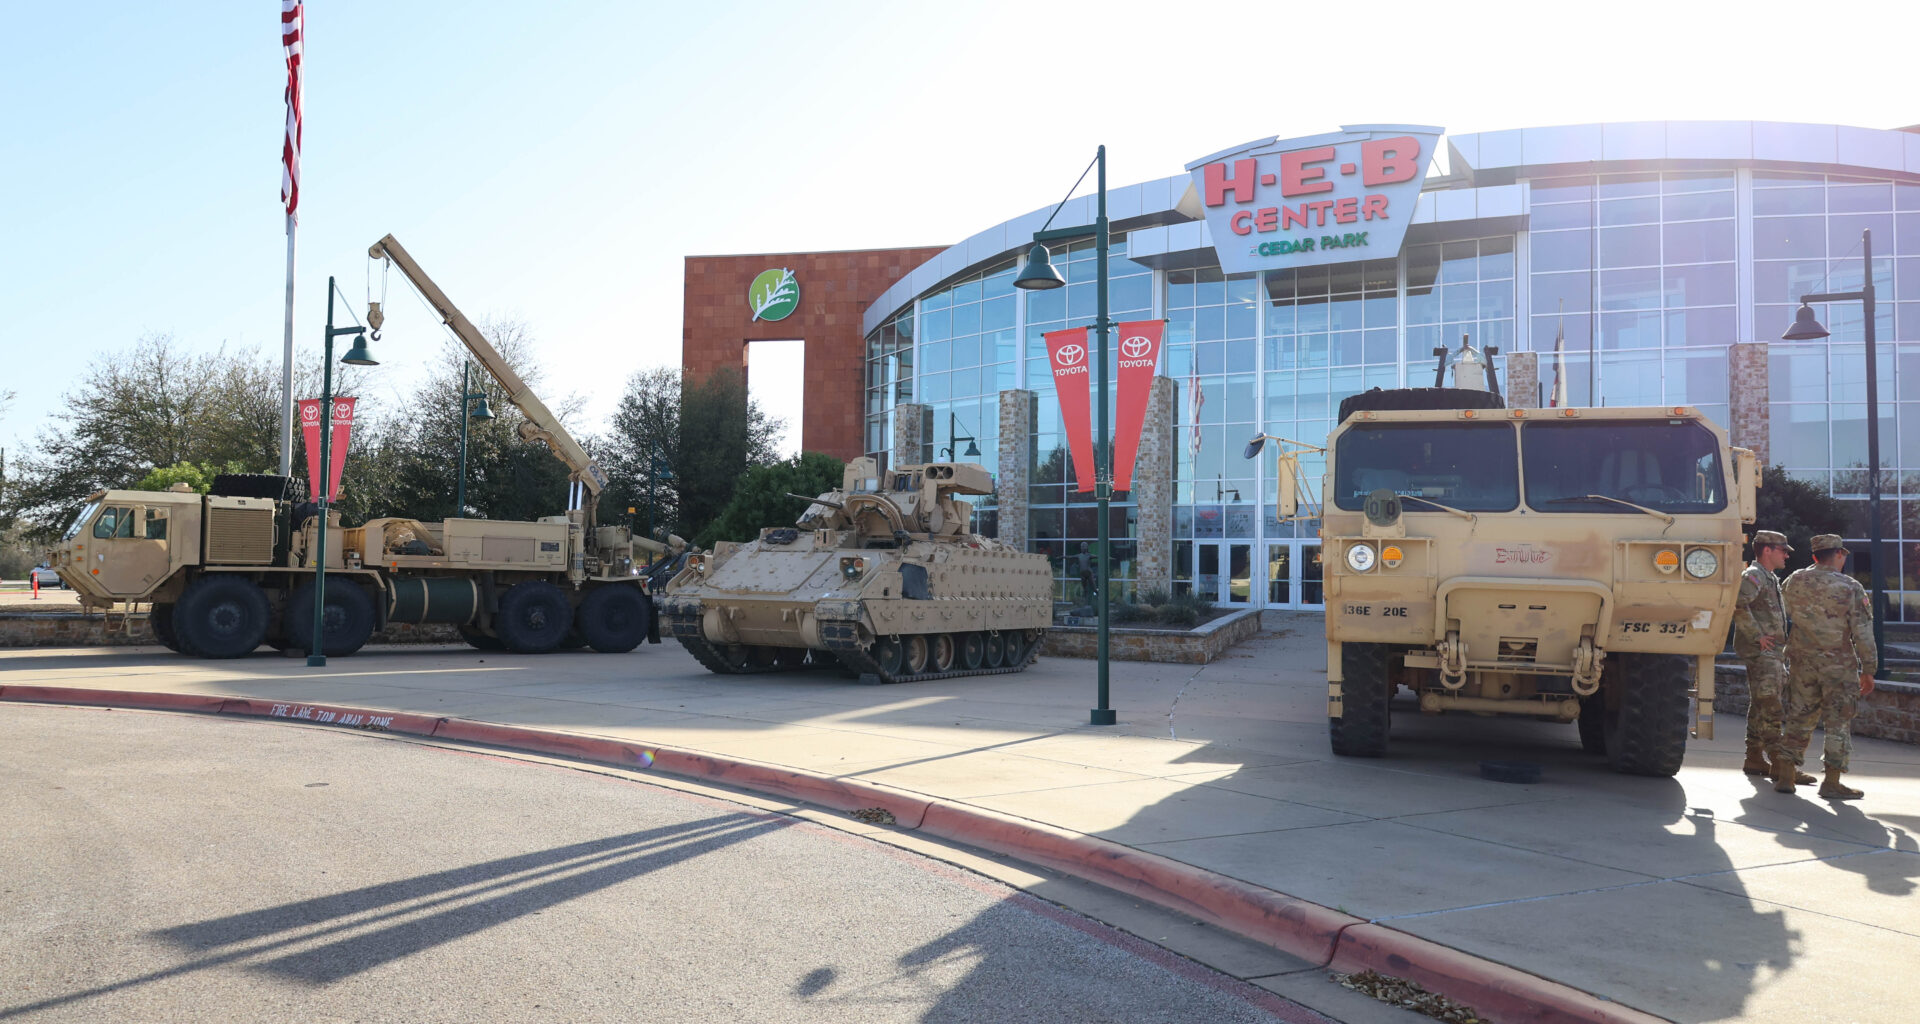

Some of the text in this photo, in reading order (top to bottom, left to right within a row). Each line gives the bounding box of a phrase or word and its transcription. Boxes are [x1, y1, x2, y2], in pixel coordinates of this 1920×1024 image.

[1203, 136, 1420, 207] H-E-B
[1230, 194, 1389, 235] CENTER
[1258, 237, 1315, 257] CEDAR
[1320, 231, 1369, 250] PARK
[1054, 365, 1088, 377] TOYOTA
[1119, 359, 1154, 369] TOYOTA
[1383, 606, 1408, 617] 20E
[1623, 622, 1687, 634] FSC 334
[270, 703, 393, 727] FIRE LANE TOW AWAY ZONE
